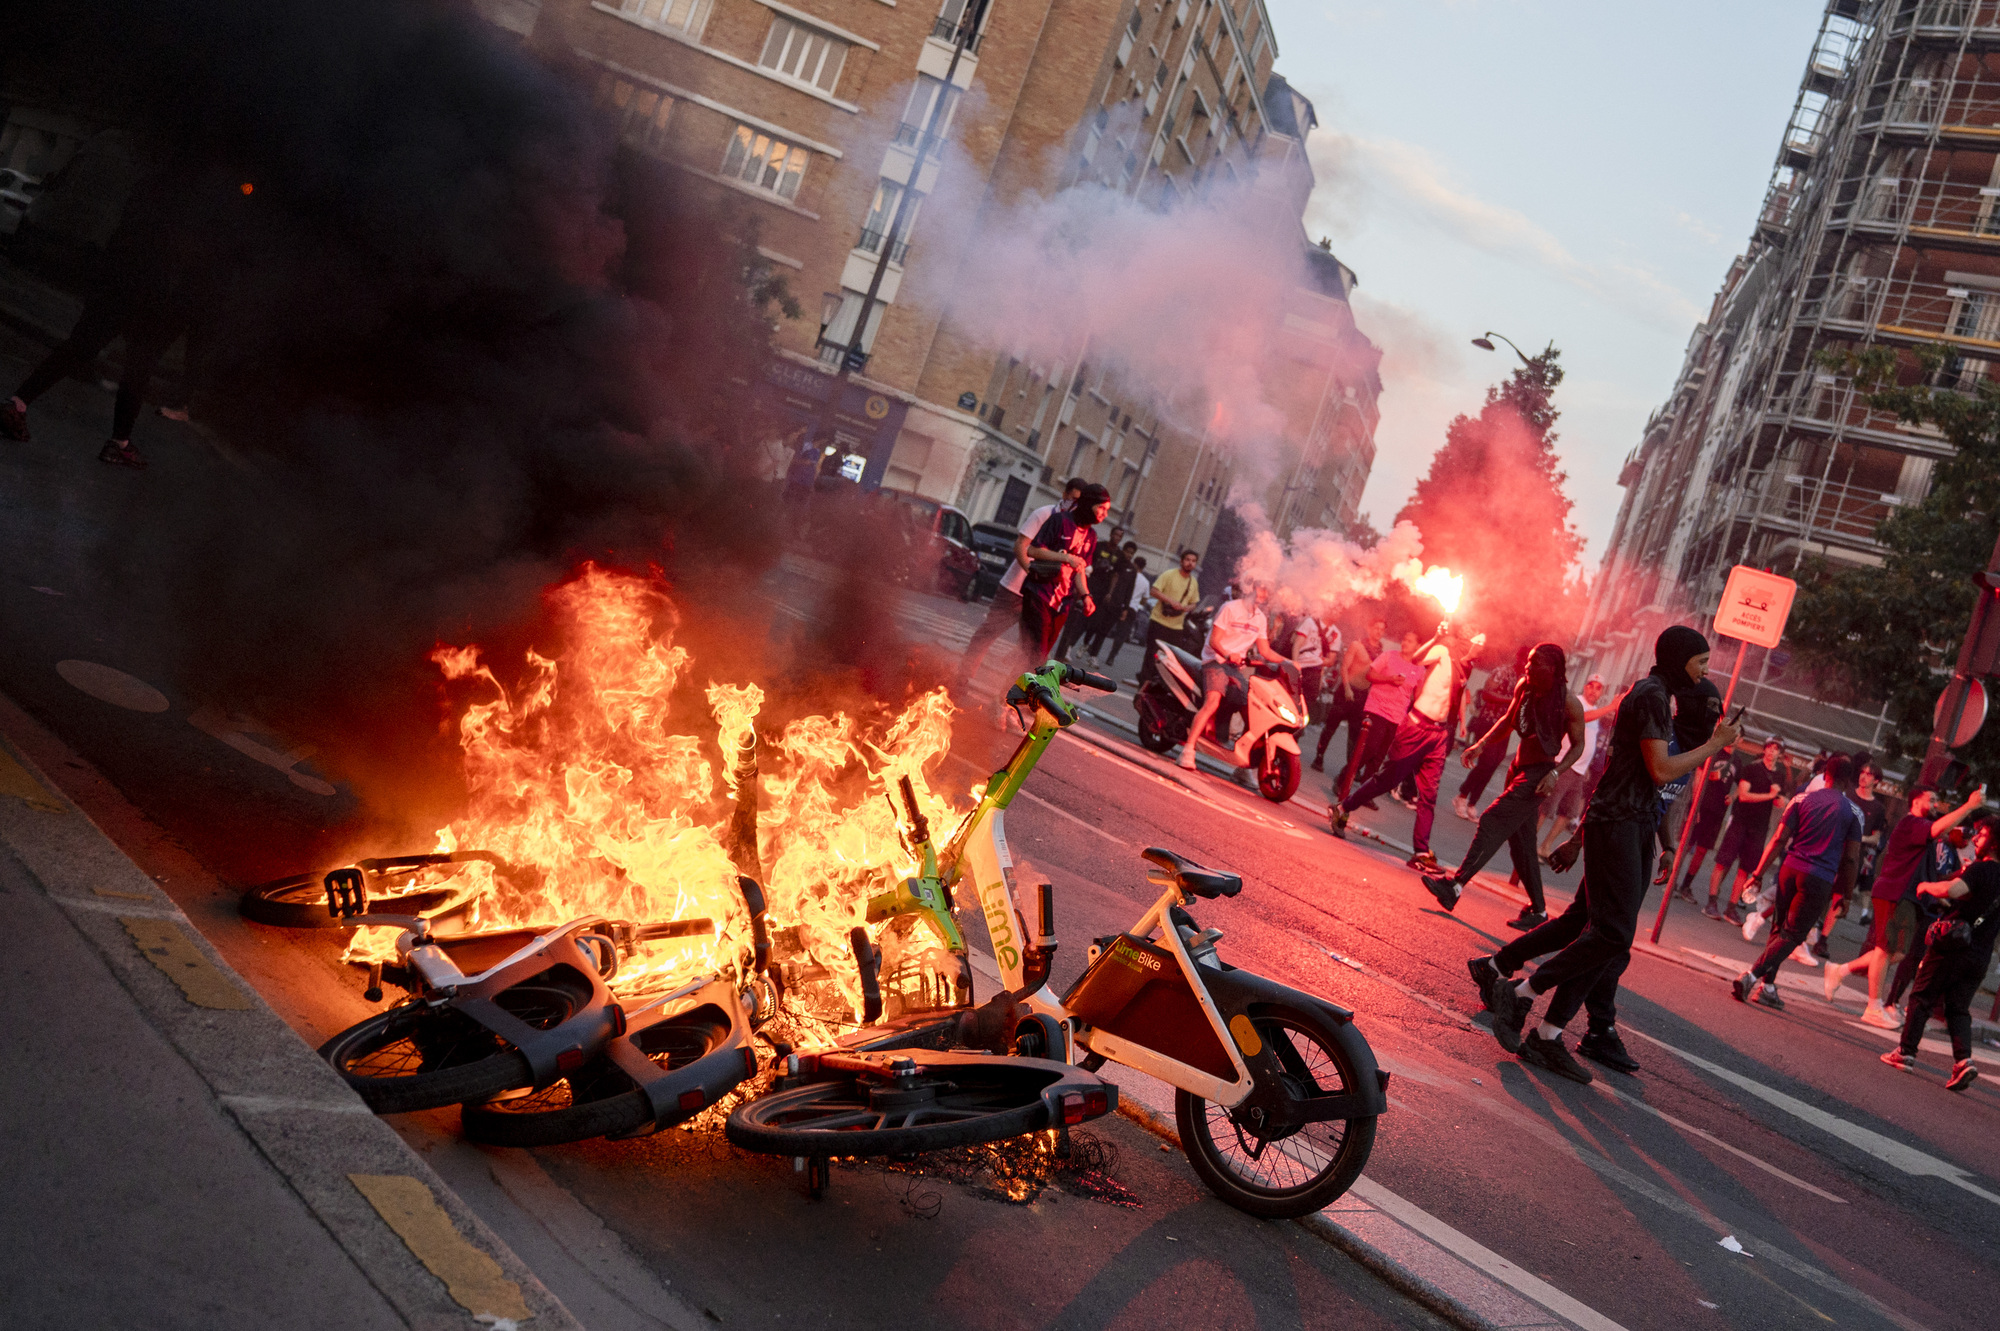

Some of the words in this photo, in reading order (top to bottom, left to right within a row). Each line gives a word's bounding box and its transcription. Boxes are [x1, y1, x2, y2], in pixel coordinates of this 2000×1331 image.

[1732, 617, 1765, 632] POMPIERS
[982, 881, 1018, 971] Lime
[1115, 940, 1161, 971] LimeBike
